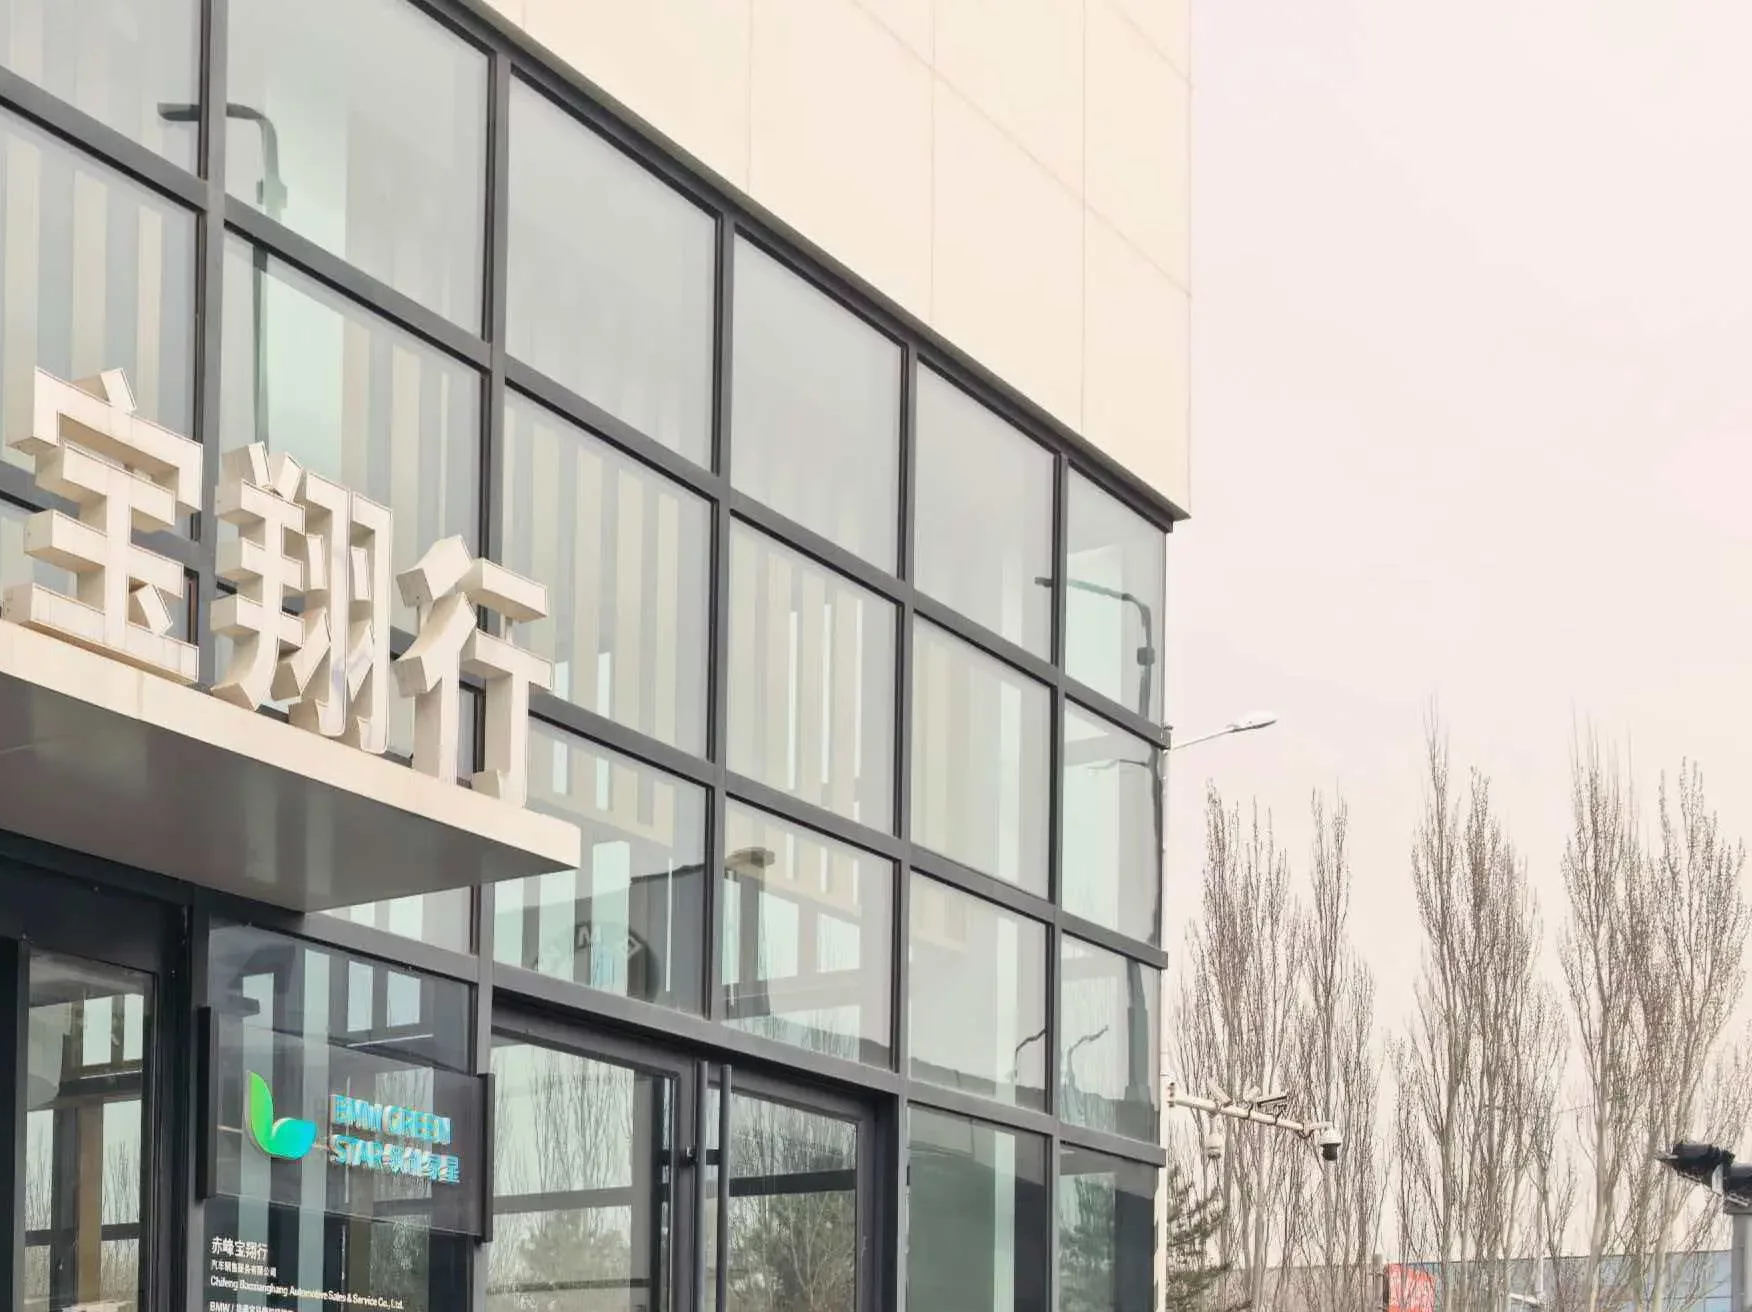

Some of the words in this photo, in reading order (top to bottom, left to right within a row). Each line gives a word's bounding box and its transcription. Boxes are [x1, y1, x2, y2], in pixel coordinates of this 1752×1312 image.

[383, 1105, 451, 1145] GREEN
[330, 1134, 383, 1168] STAR
[211, 1236, 268, 1261] 赤峰宝翔行
[211, 1260, 277, 1277] 汽车销售服务有限公司
[210, 1275, 238, 1290] Chifeng
[328, 1290, 345, 1303] Sales
[353, 1294, 377, 1306] Service
[209, 1301, 230, 1312] BMW
